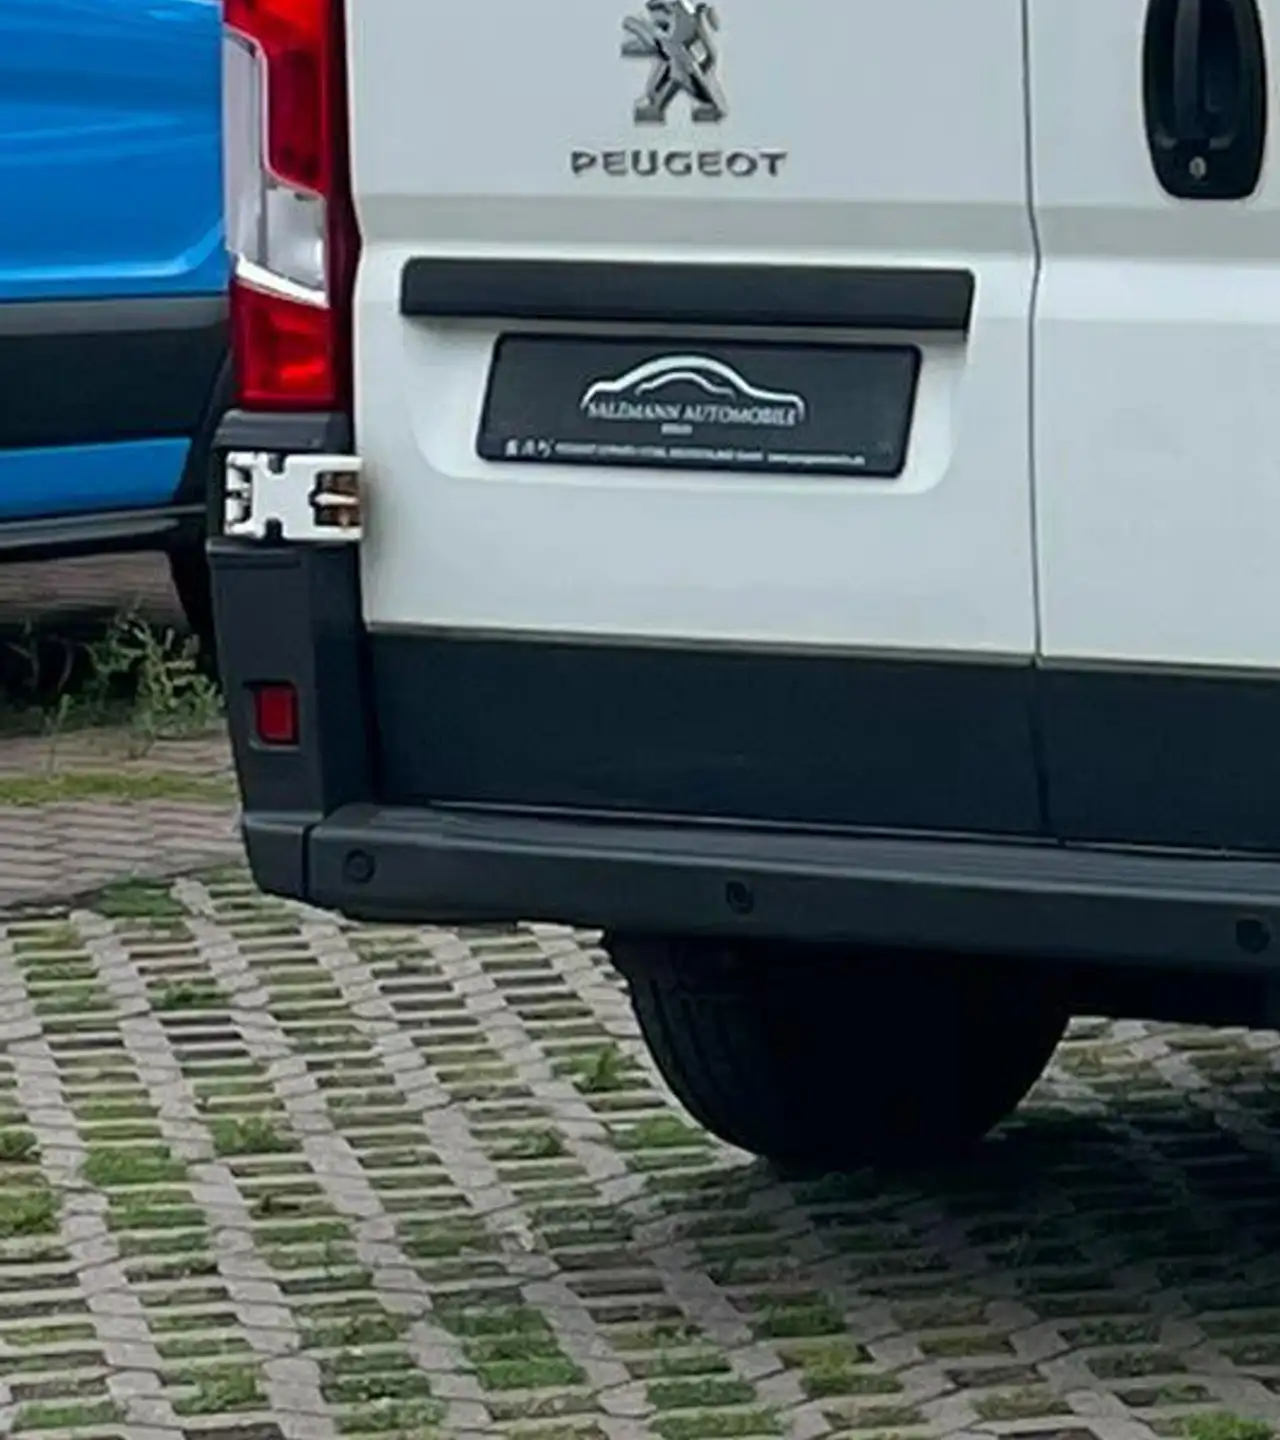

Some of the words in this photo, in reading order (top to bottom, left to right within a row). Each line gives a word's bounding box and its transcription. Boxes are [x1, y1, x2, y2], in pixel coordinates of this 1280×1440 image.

[571, 148, 788, 176] PEUGEOT
[587, 402, 681, 422] SALZMANN
[684, 405, 796, 427] AUTOMOBILE
